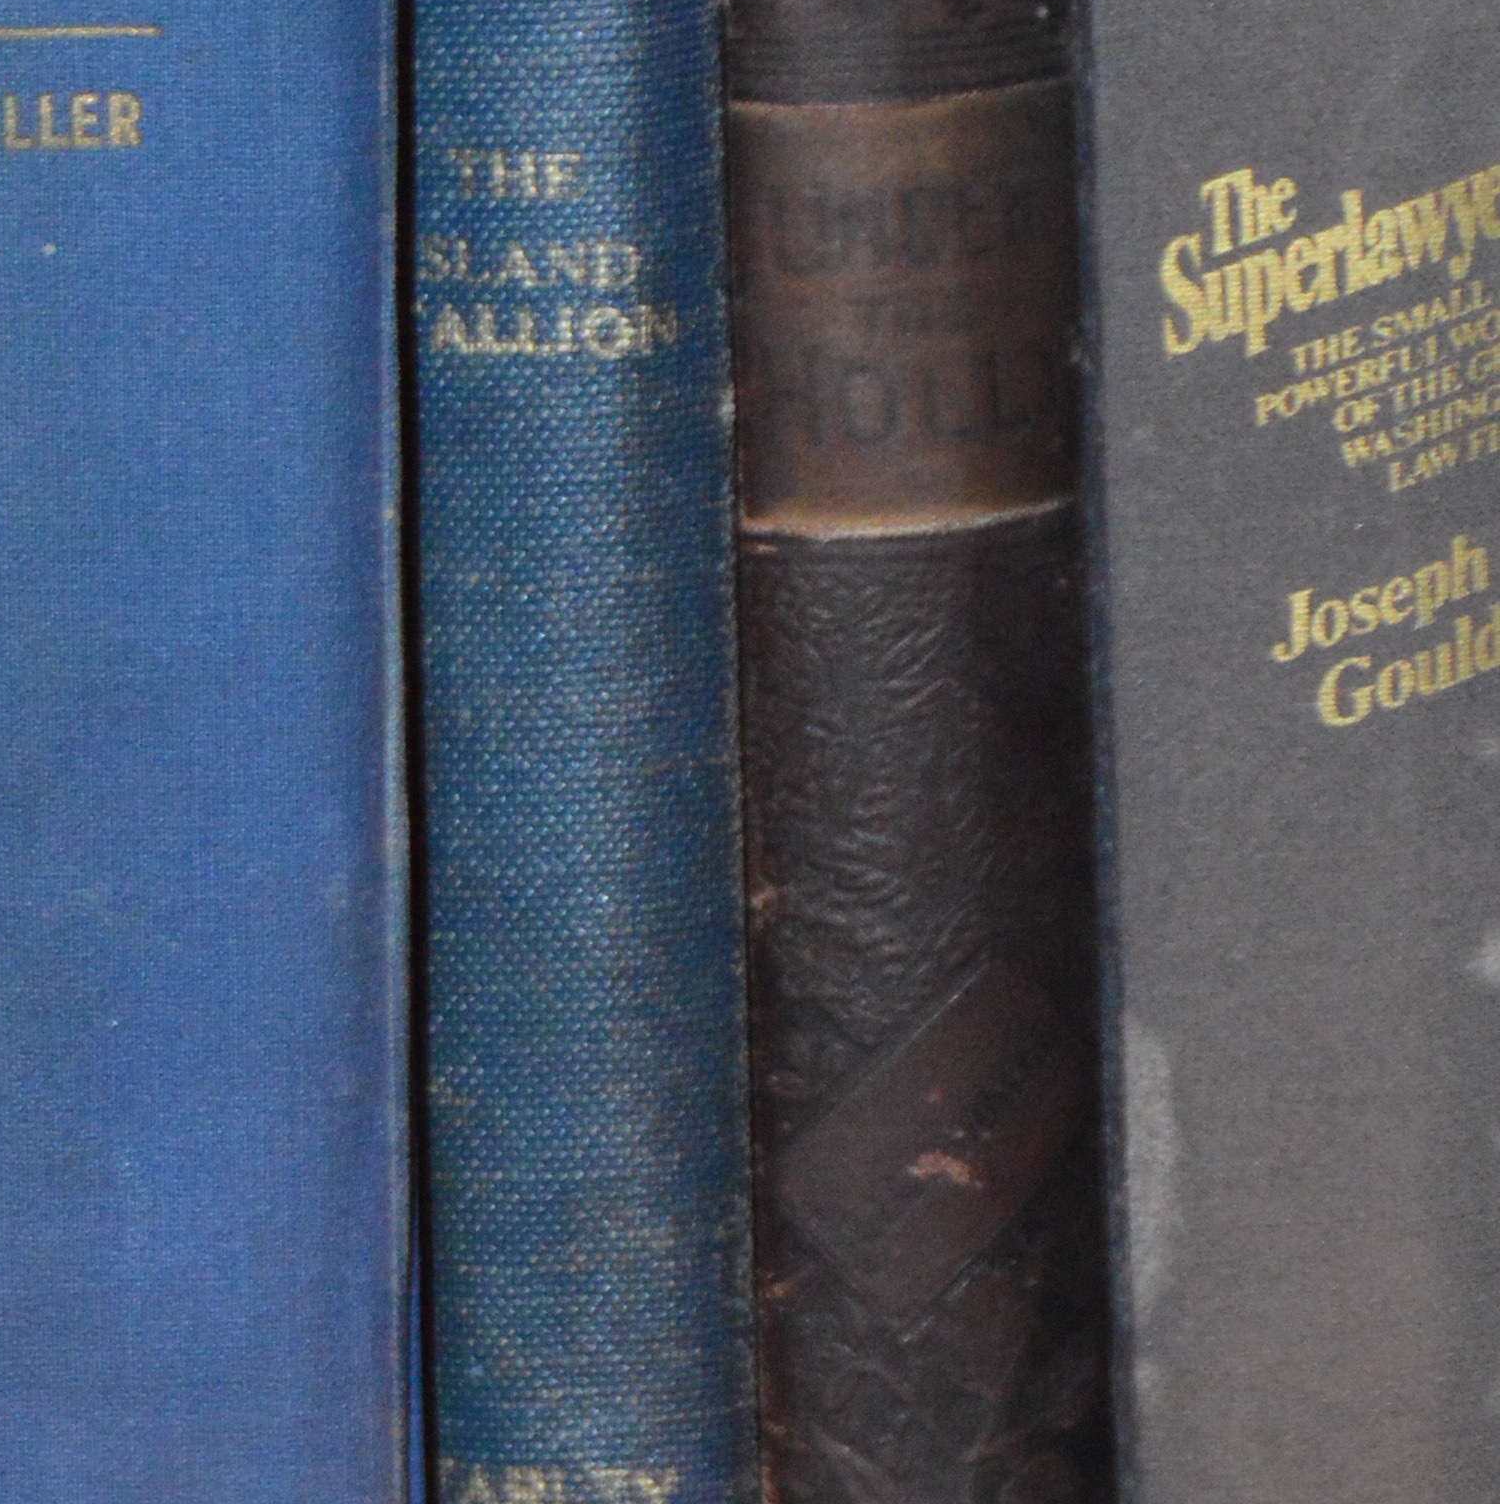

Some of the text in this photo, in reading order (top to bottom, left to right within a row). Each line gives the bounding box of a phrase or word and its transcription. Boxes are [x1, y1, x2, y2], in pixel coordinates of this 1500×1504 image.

[448, 148, 587, 198] THE
[1200, 167, 1297, 256] The
[412, 299, 678, 360] ALLION
[1290, 279, 1491, 374] THE SMALL
[1255, 335, 1451, 428] POWERFUL
[1332, 396, 1380, 433] OF
[1390, 363, 1465, 413] THE
[1389, 442, 1459, 493] LAW
[1270, 534, 1490, 663] Joseph
